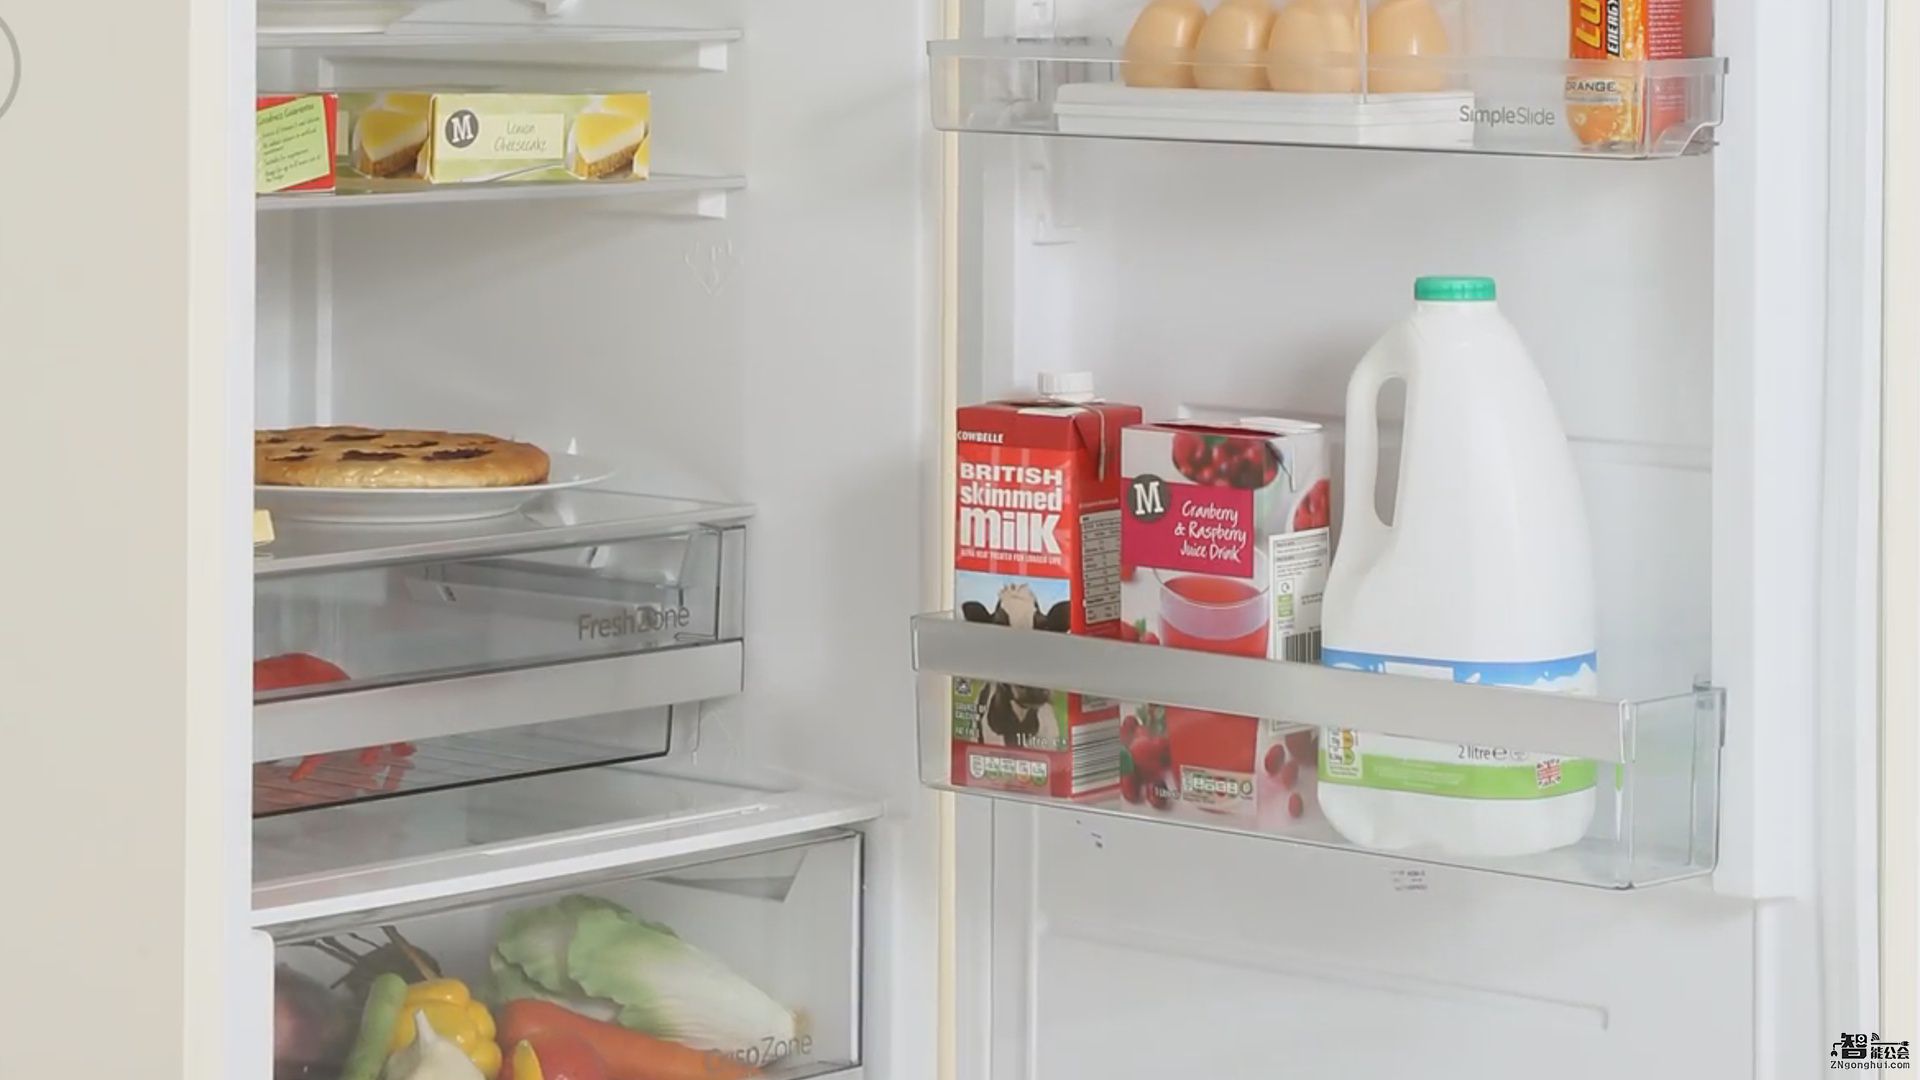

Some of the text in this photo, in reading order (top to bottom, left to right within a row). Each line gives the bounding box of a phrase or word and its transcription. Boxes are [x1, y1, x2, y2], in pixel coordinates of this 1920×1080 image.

[450, 113, 475, 144] M
[506, 120, 536, 136] Lemon
[1459, 104, 1556, 128] SimpleSlide
[493, 136, 549, 153] Cheesecake
[957, 430, 1004, 444] COWBELLE
[960, 461, 1064, 486] BRITISH
[959, 480, 1063, 512] skimmed
[1133, 481, 1165, 515] M
[1182, 499, 1239, 529] Cranberry
[1173, 520, 1247, 550] & Raspberry
[1179, 539, 1242, 564] Juice Drink
[577, 605, 691, 642] FreshZone
[1458, 745, 1466, 760] 2
[1467, 744, 1492, 761] litre
